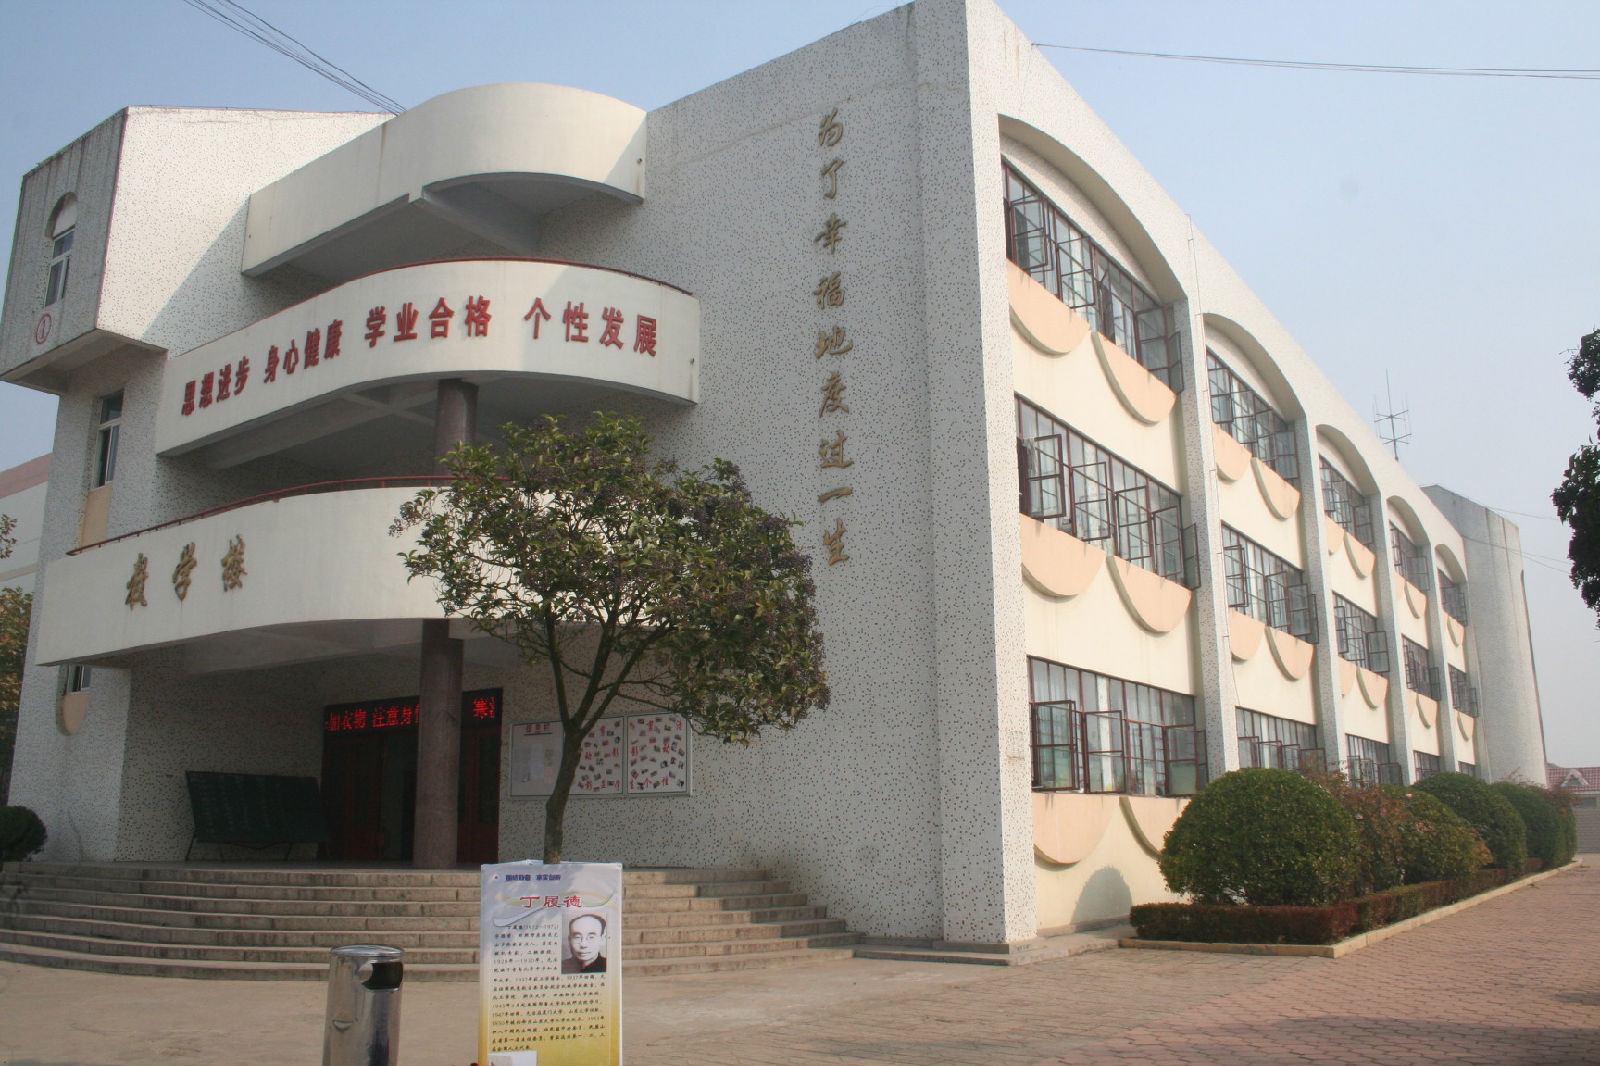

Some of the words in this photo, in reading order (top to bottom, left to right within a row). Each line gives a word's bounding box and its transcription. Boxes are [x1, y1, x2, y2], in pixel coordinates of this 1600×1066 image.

[181, 356, 250, 416] 思想进步
[263, 318, 344, 385] 身心健康
[364, 294, 493, 348] 学业合格
[523, 297, 658, 357] 个性发展
[812, 107, 854, 566] 为了幸福地度过一生
[372, 704, 420, 728] 注意身
[519, 895, 583, 908] 丁履德
